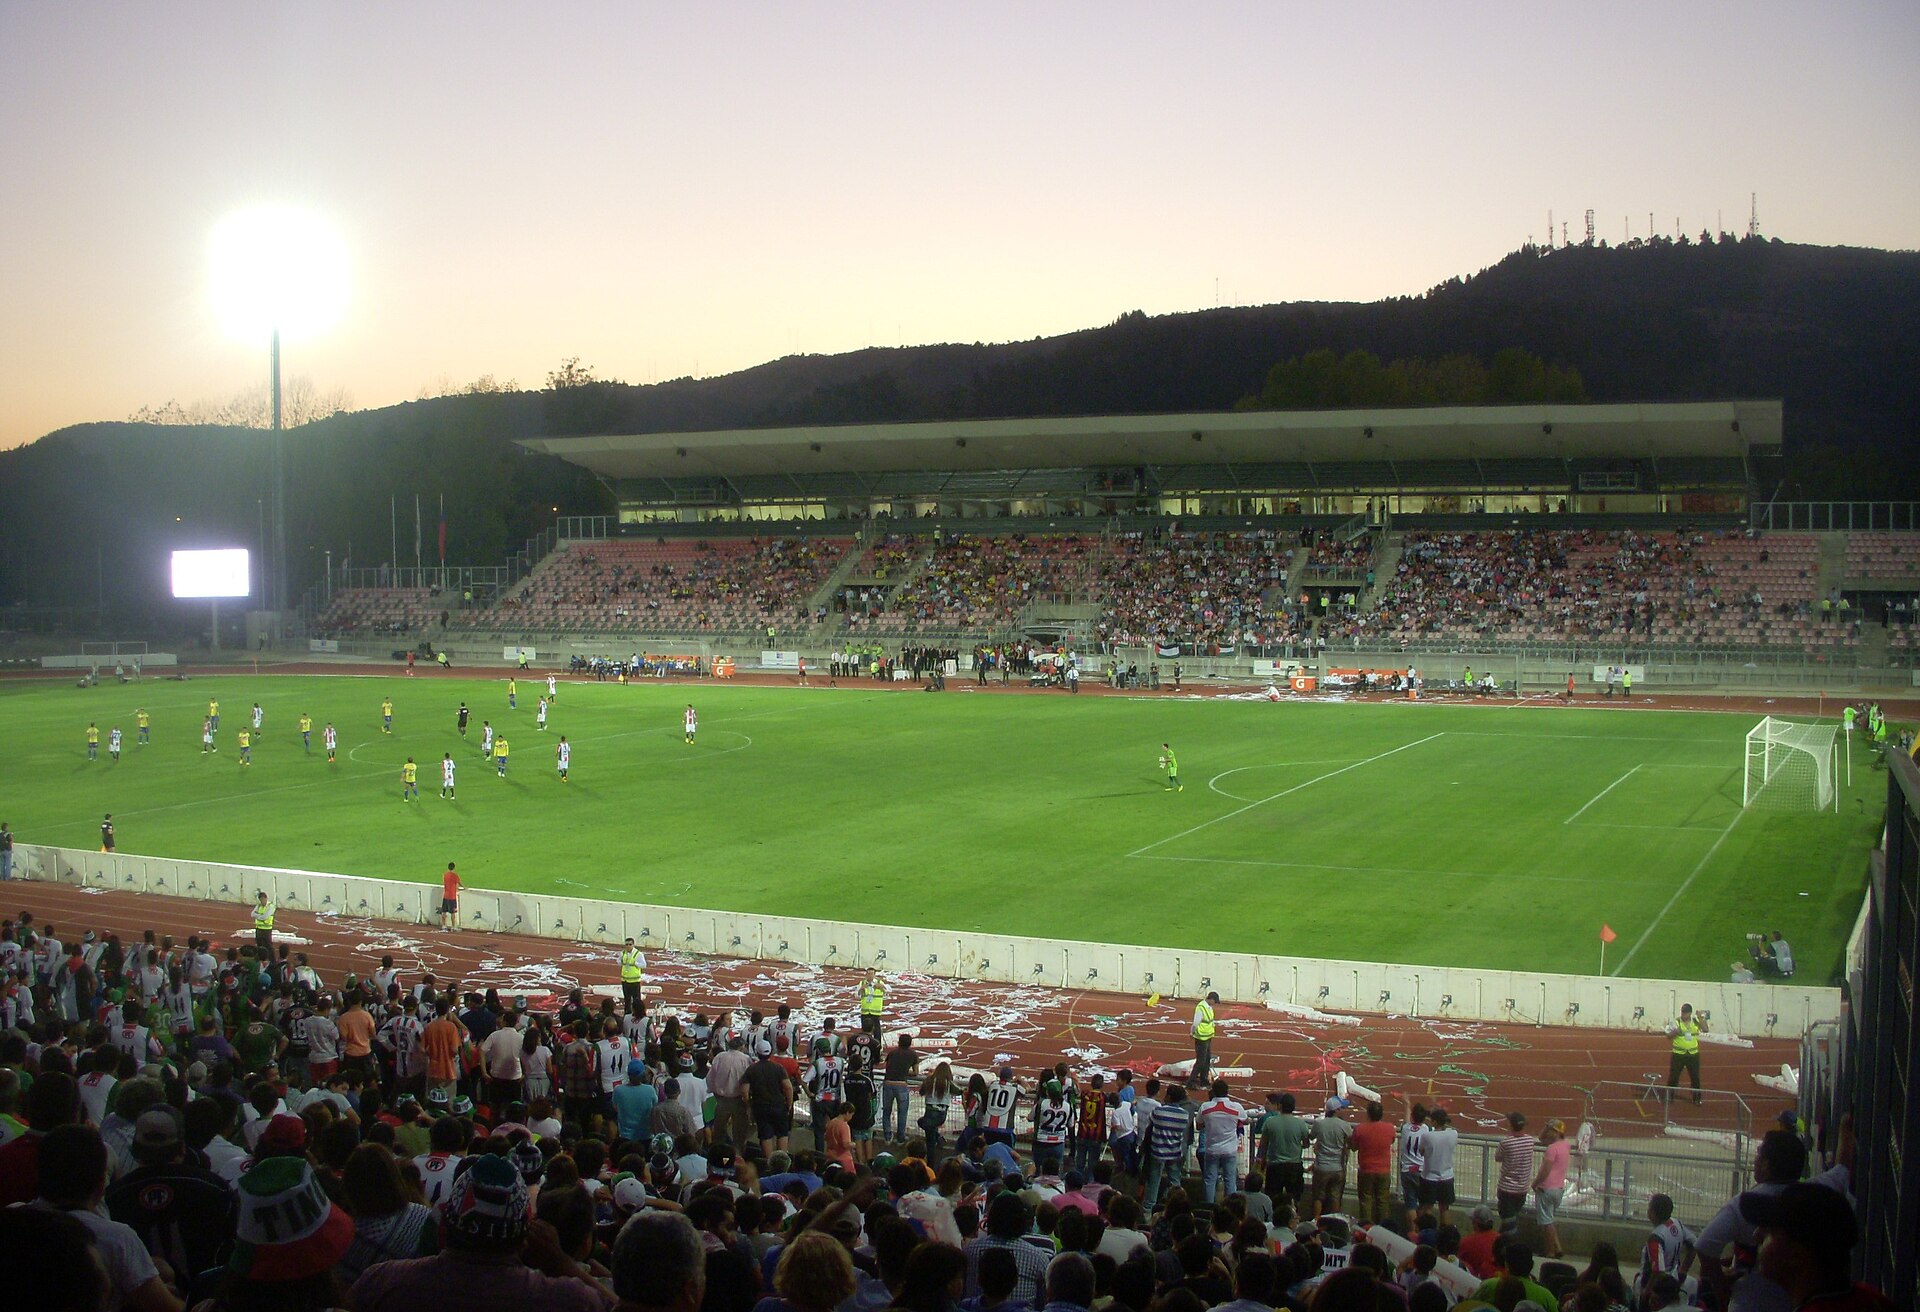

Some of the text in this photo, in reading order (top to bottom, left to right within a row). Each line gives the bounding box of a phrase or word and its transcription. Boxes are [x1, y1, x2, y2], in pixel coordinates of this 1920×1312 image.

[821, 1067, 841, 1089] 10
[990, 1088, 1009, 1108] 10
[1040, 1109, 1067, 1132] 22
